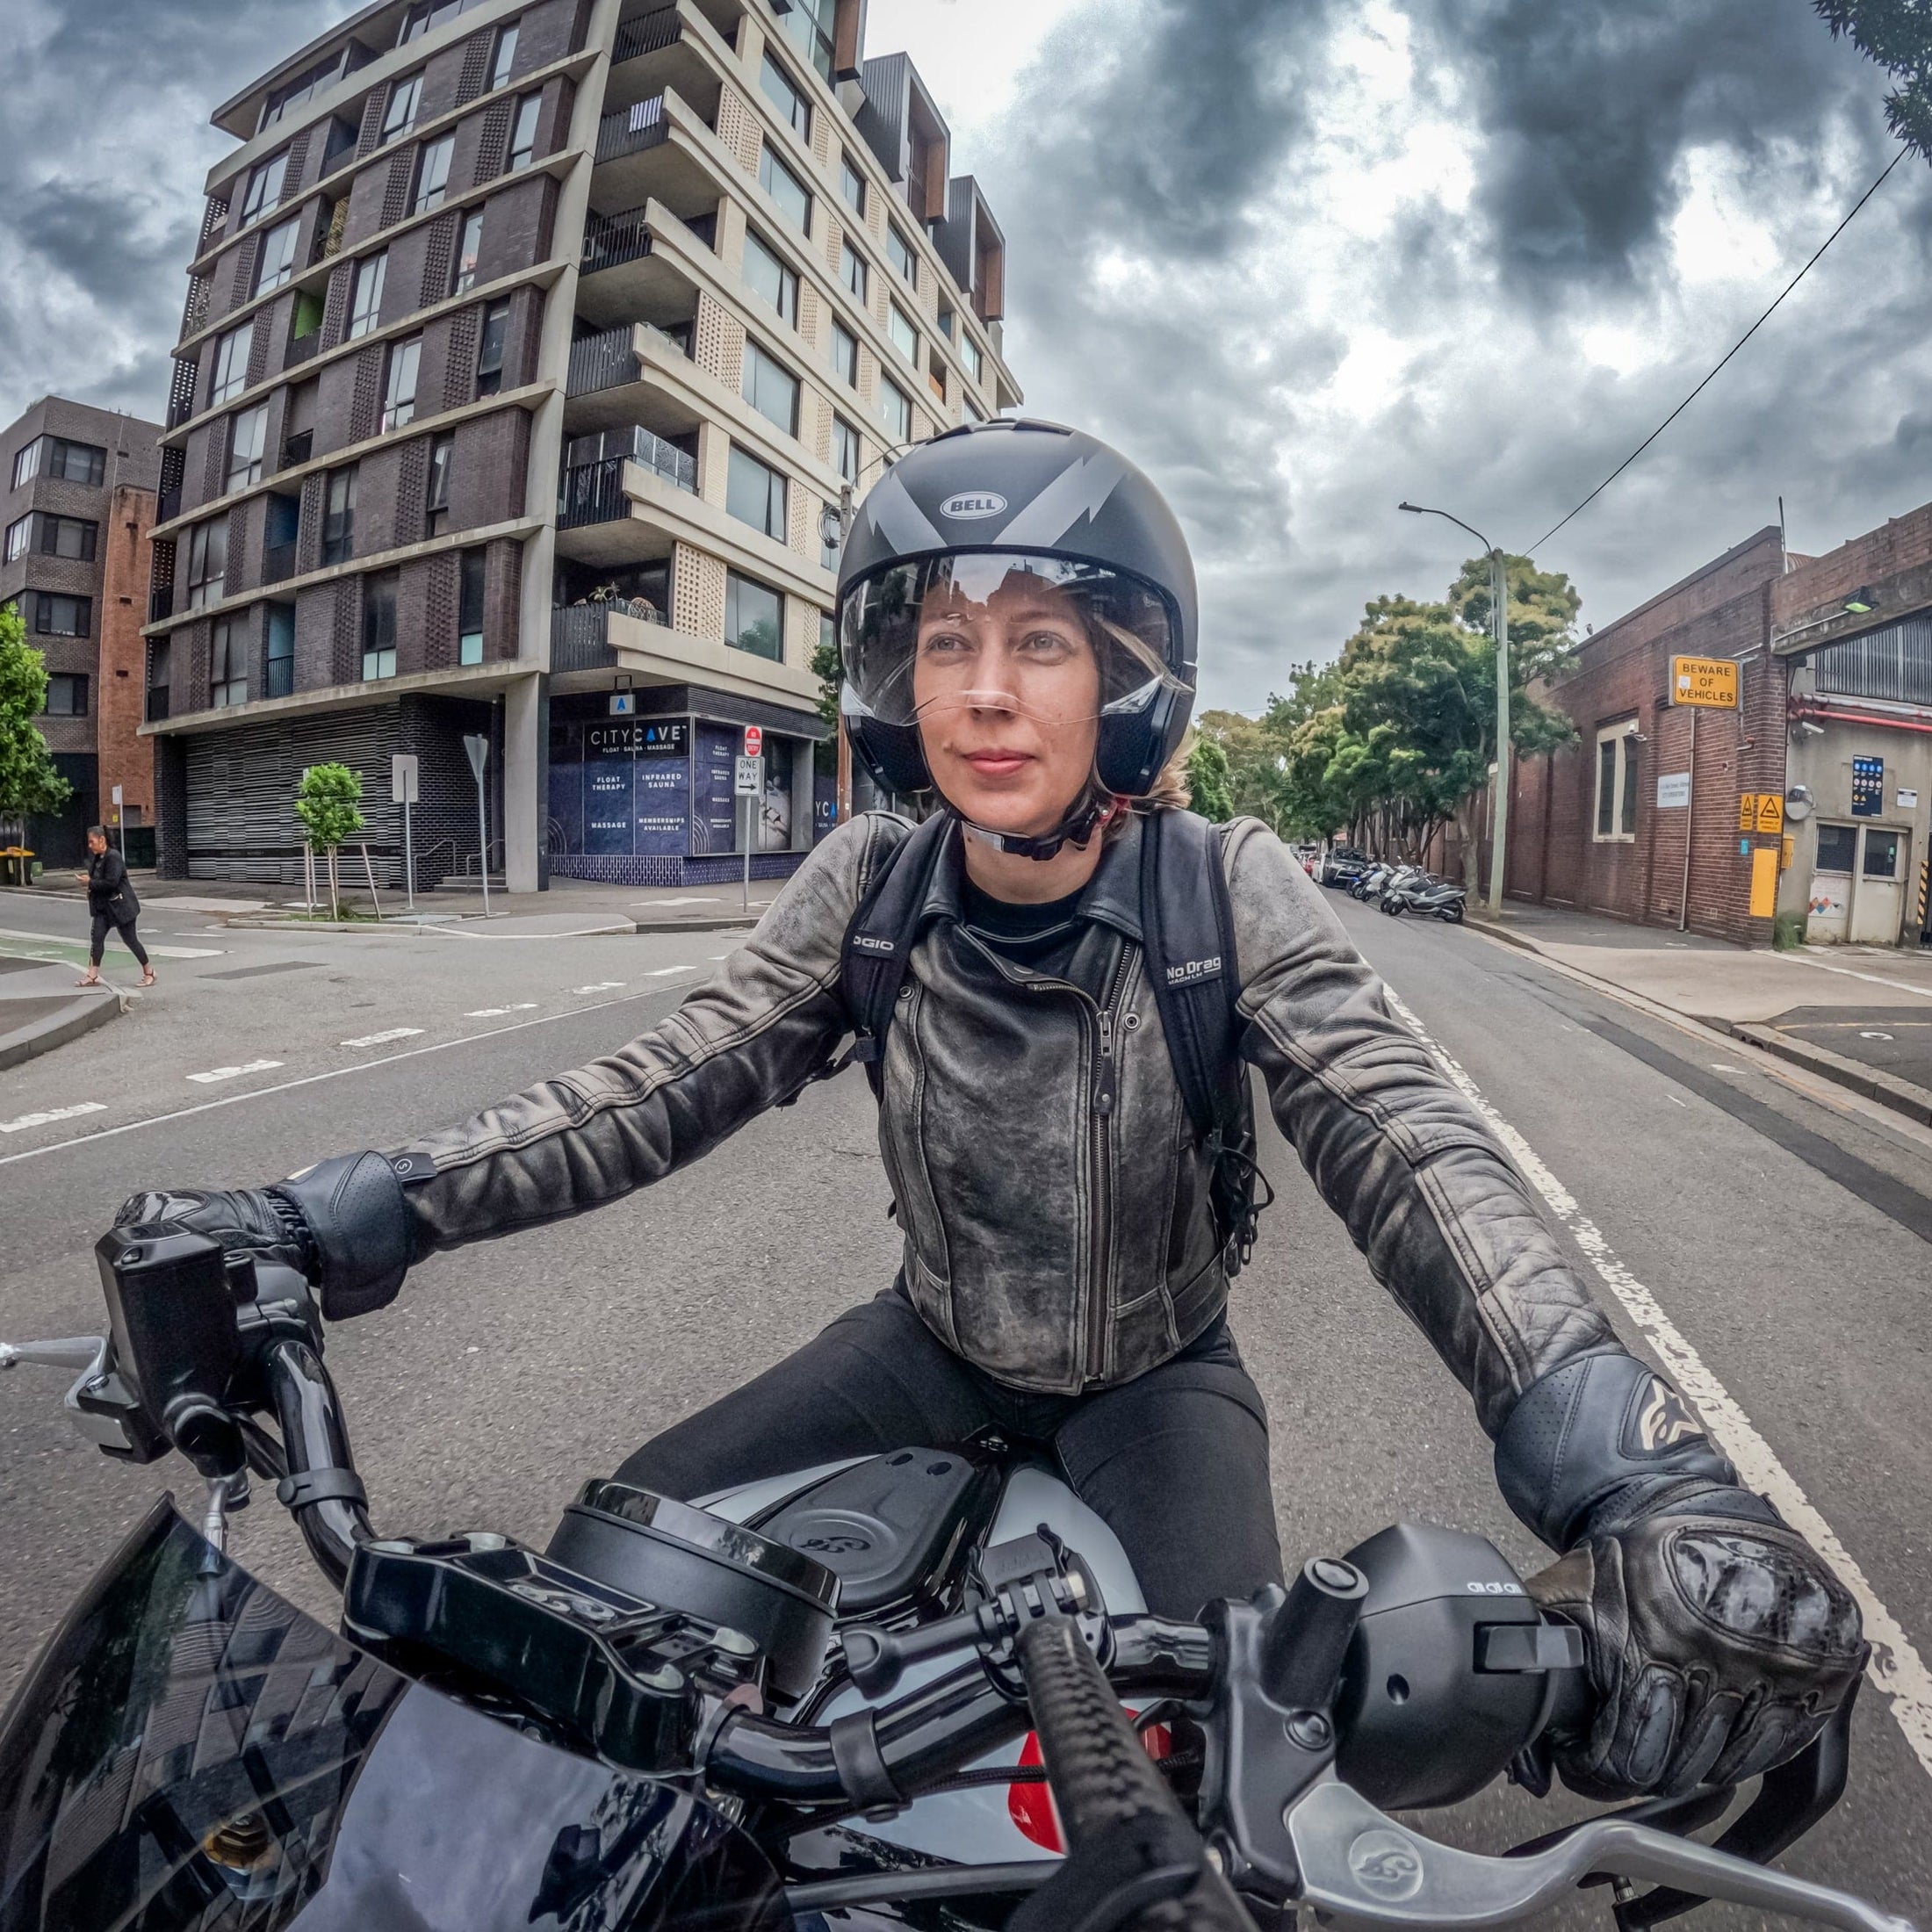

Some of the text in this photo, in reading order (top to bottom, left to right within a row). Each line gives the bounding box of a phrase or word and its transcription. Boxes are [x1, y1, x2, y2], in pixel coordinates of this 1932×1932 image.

[950, 499, 996, 512] BELL
[1683, 663, 1731, 677] BEWARE
[1699, 677, 1714, 688] OF
[1679, 688, 1734, 703] VEHICLES
[739, 760, 757, 769] ONE
[853, 935, 895, 951] OGIO
[1166, 956, 1222, 979] No Drag
